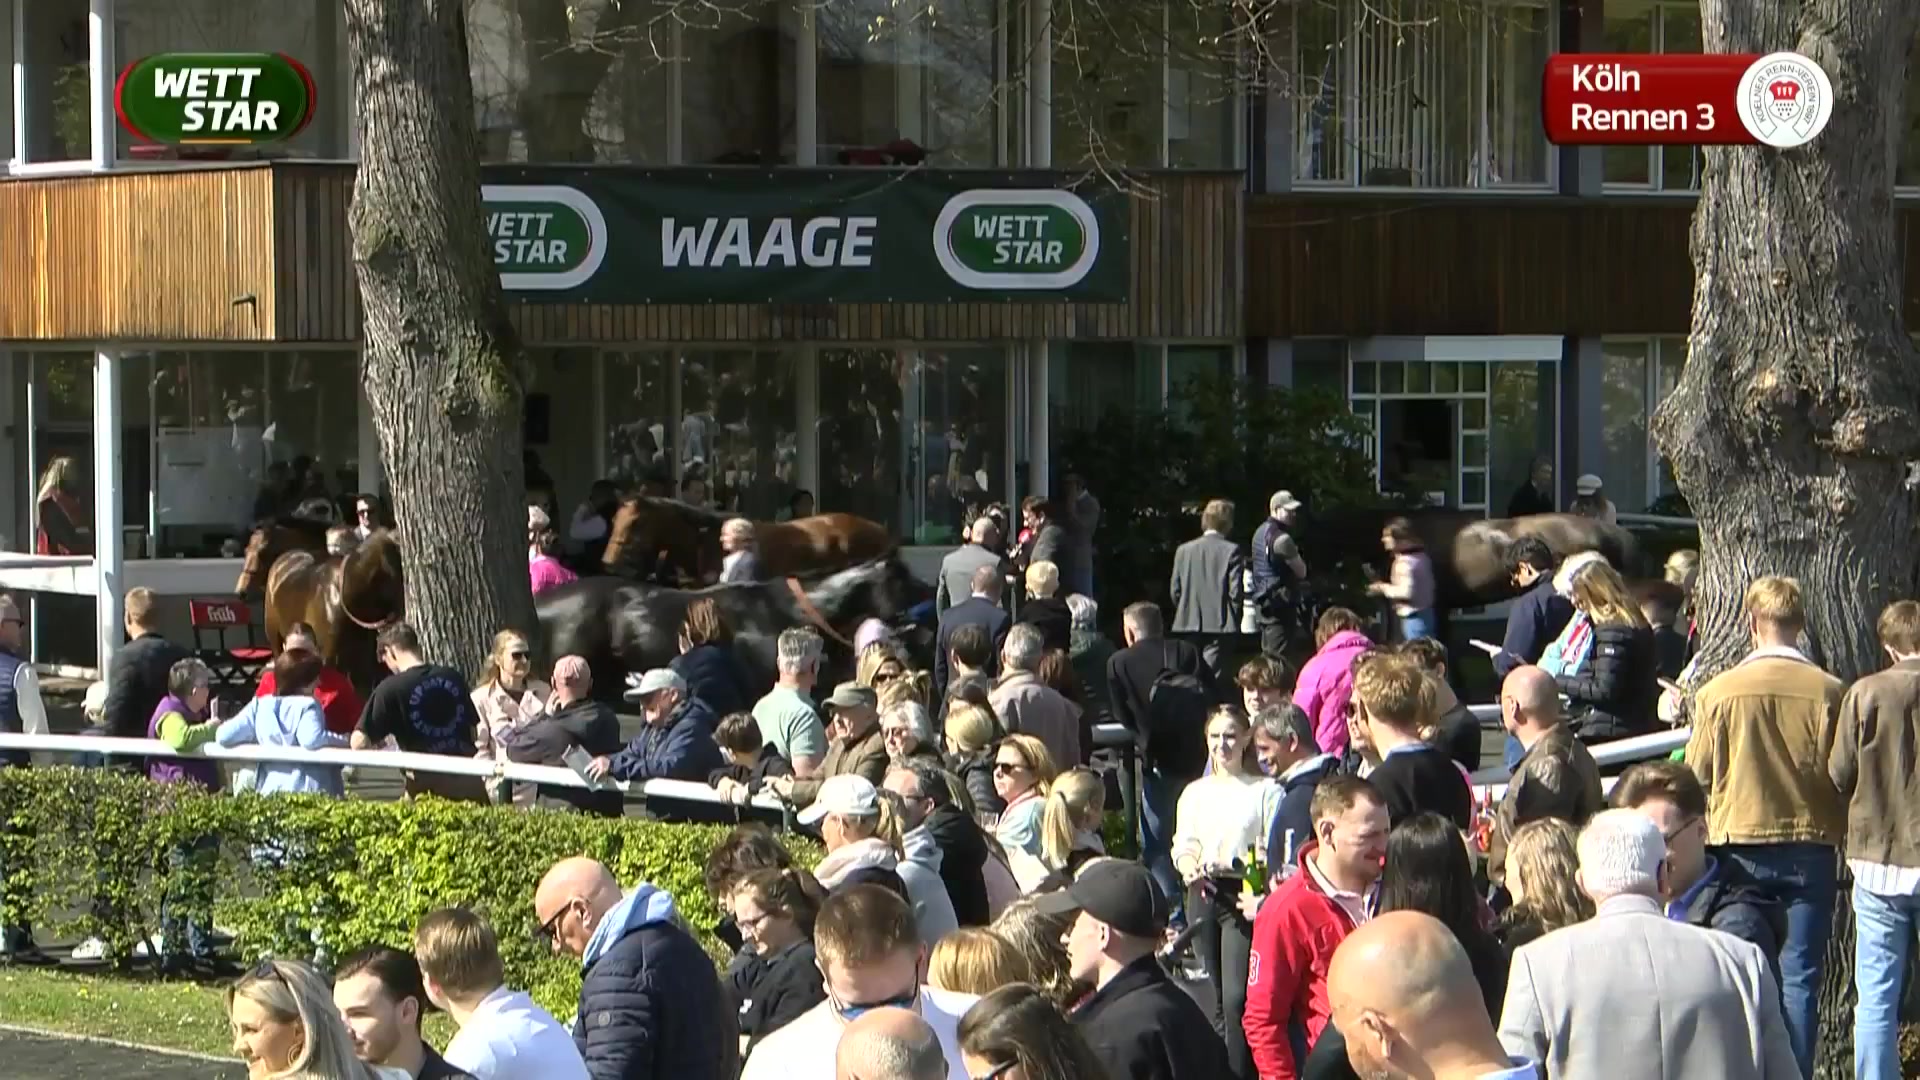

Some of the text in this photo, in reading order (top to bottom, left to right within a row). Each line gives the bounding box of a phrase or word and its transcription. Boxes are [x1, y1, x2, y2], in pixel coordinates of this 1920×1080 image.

[973, 215, 1048, 239] WETT
[494, 240, 567, 264] STAR
[661, 216, 878, 267] WAAGE
[993, 240, 1063, 264] STAR
